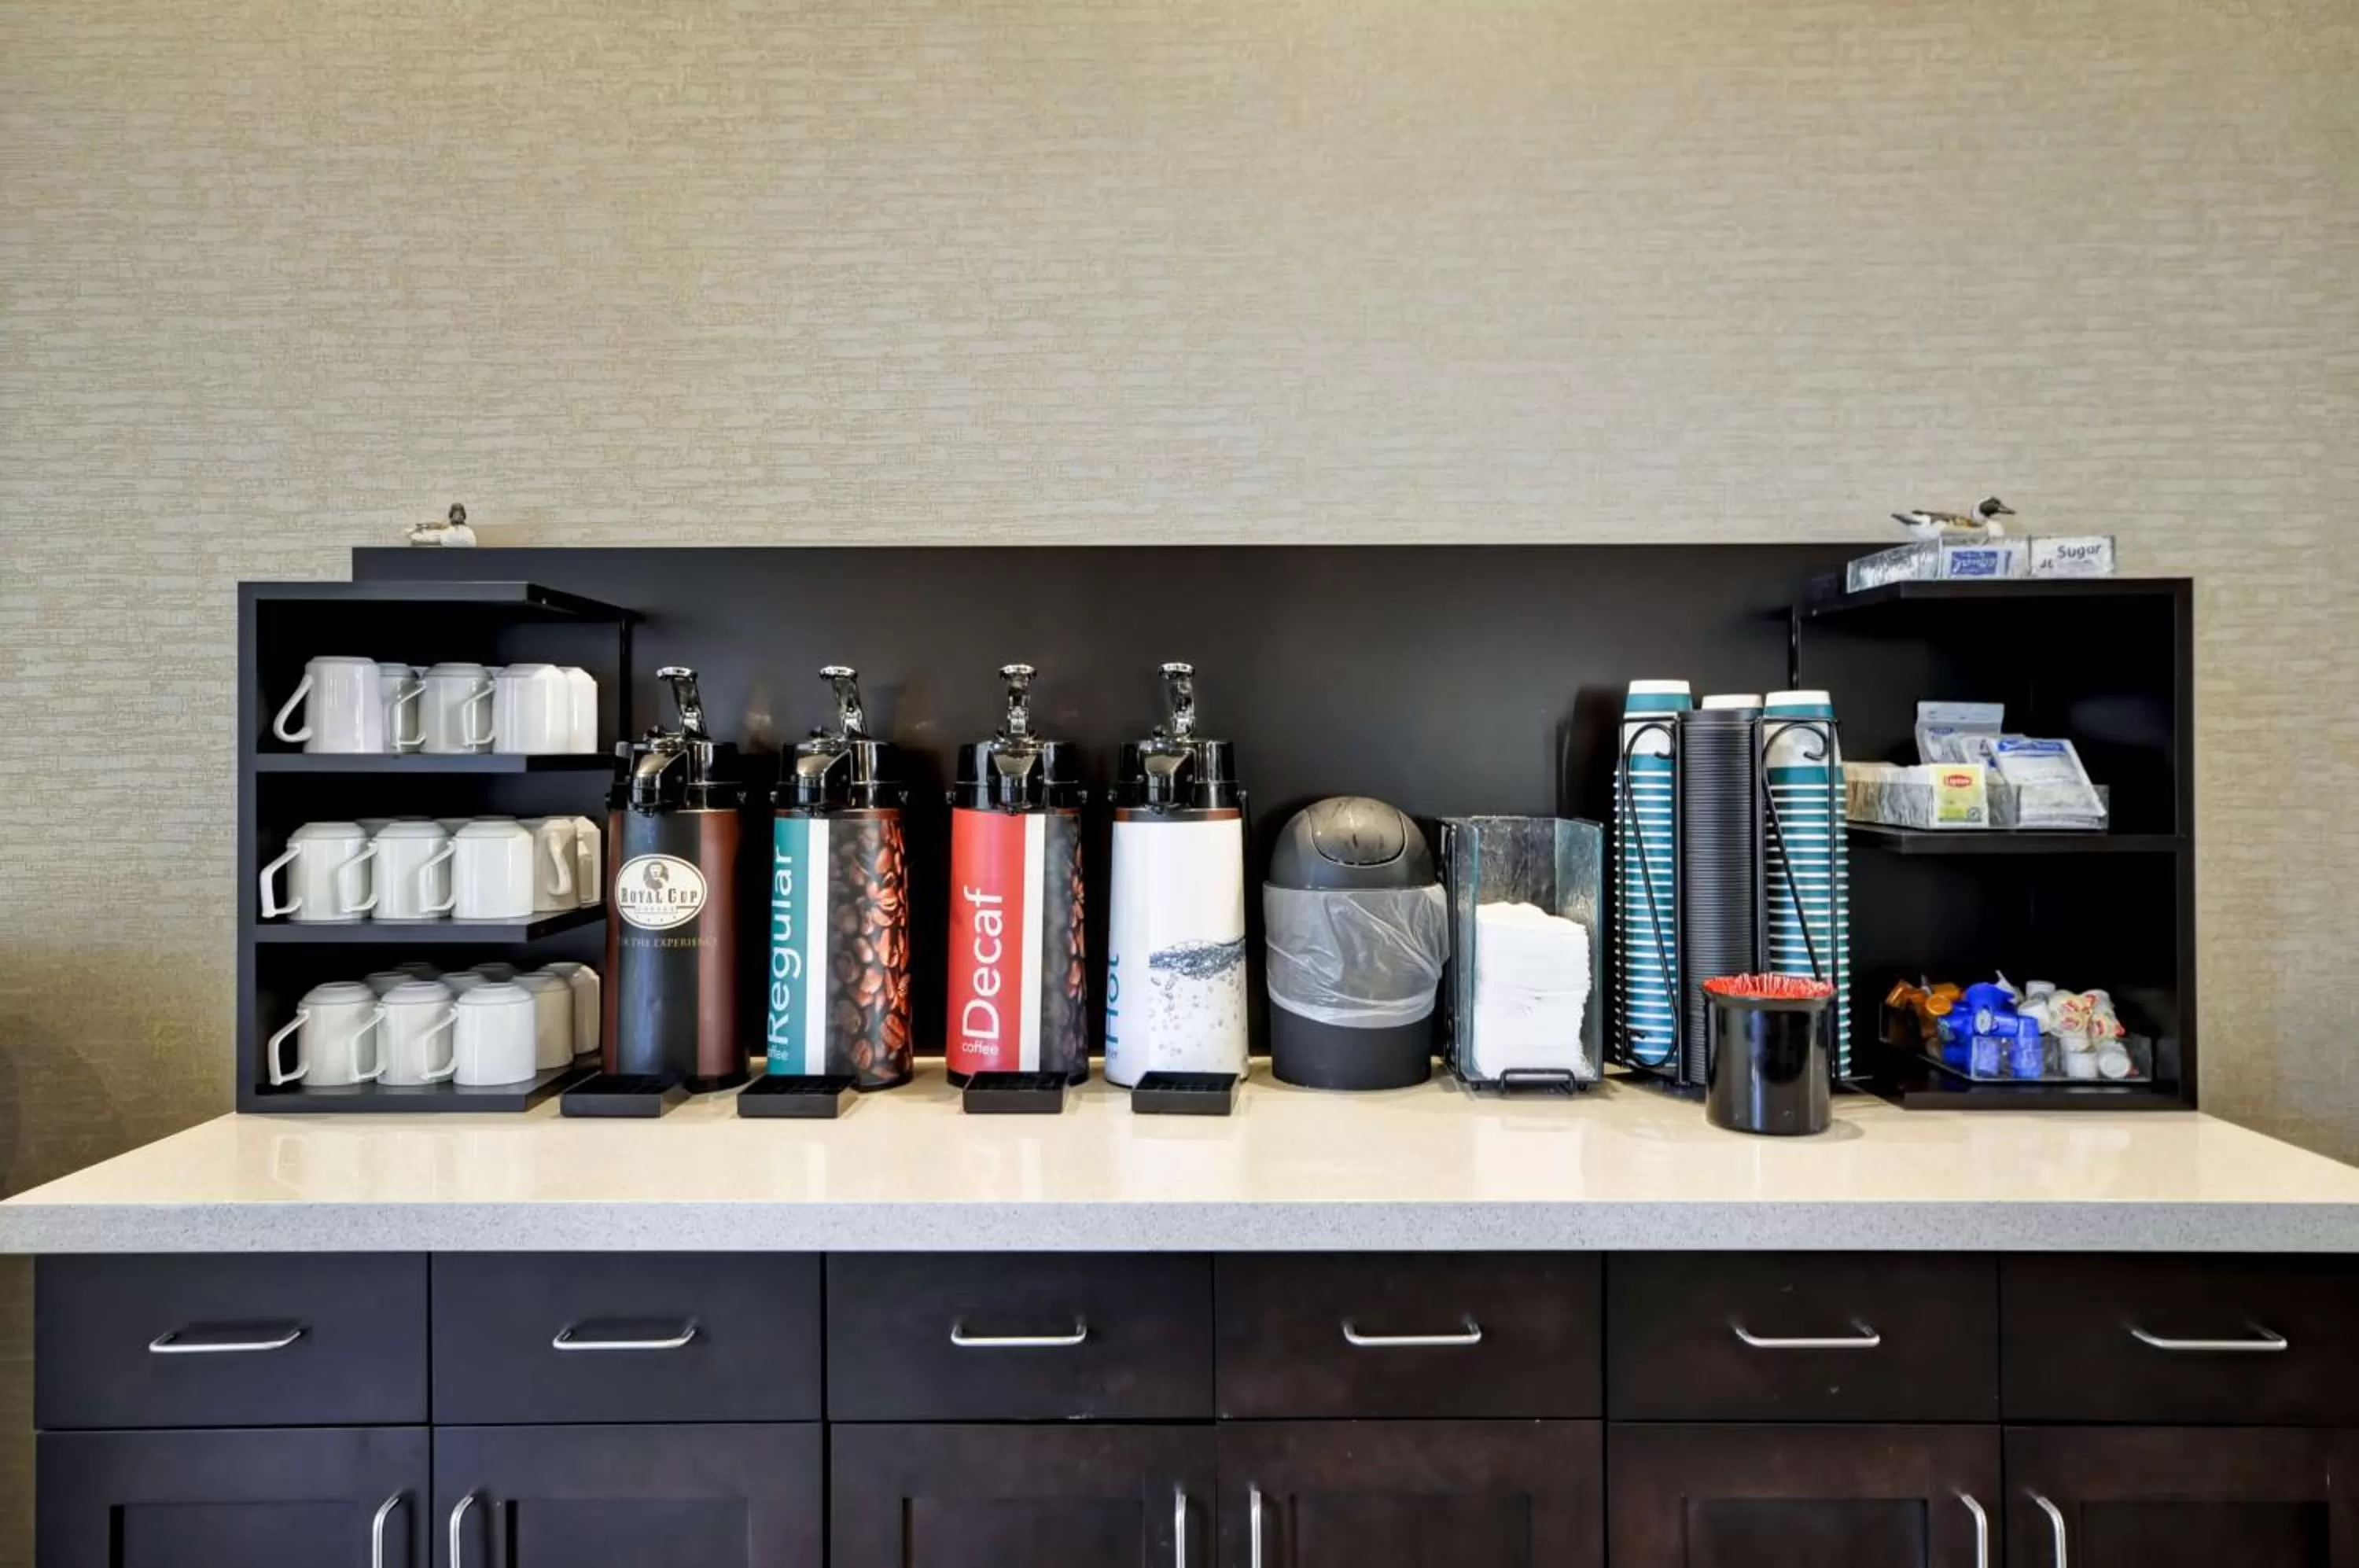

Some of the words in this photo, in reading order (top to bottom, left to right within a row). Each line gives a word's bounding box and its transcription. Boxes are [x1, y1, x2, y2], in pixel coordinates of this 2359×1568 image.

[2057, 544, 2102, 560] Sugar
[767, 845, 801, 1044] Regular
[962, 885, 1003, 1040] Decaf
[962, 1039, 999, 1055] coffee
